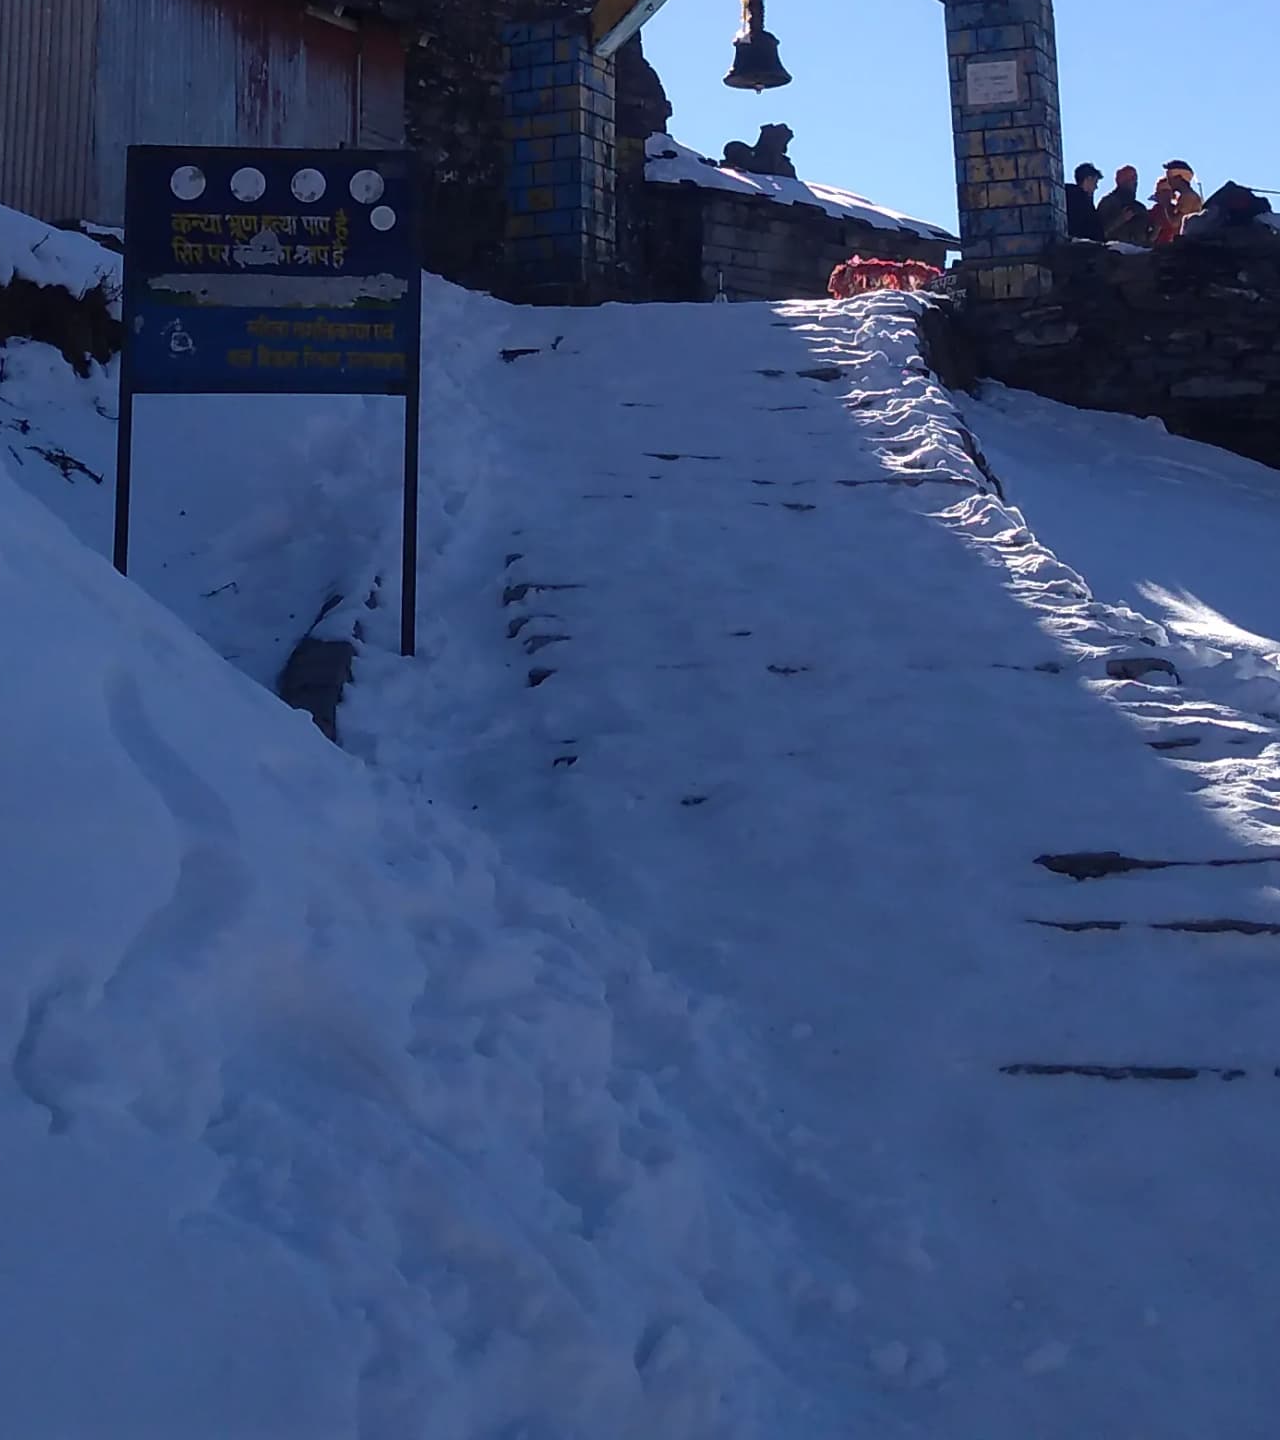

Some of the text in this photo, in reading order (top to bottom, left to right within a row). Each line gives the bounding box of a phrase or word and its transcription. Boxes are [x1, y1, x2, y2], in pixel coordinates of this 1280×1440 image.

[172, 214, 222, 234] कन्या
[300, 215, 331, 235] पाप
[335, 207, 349, 240] है
[171, 236, 204, 265] सिर
[206, 243, 231, 266] पर
